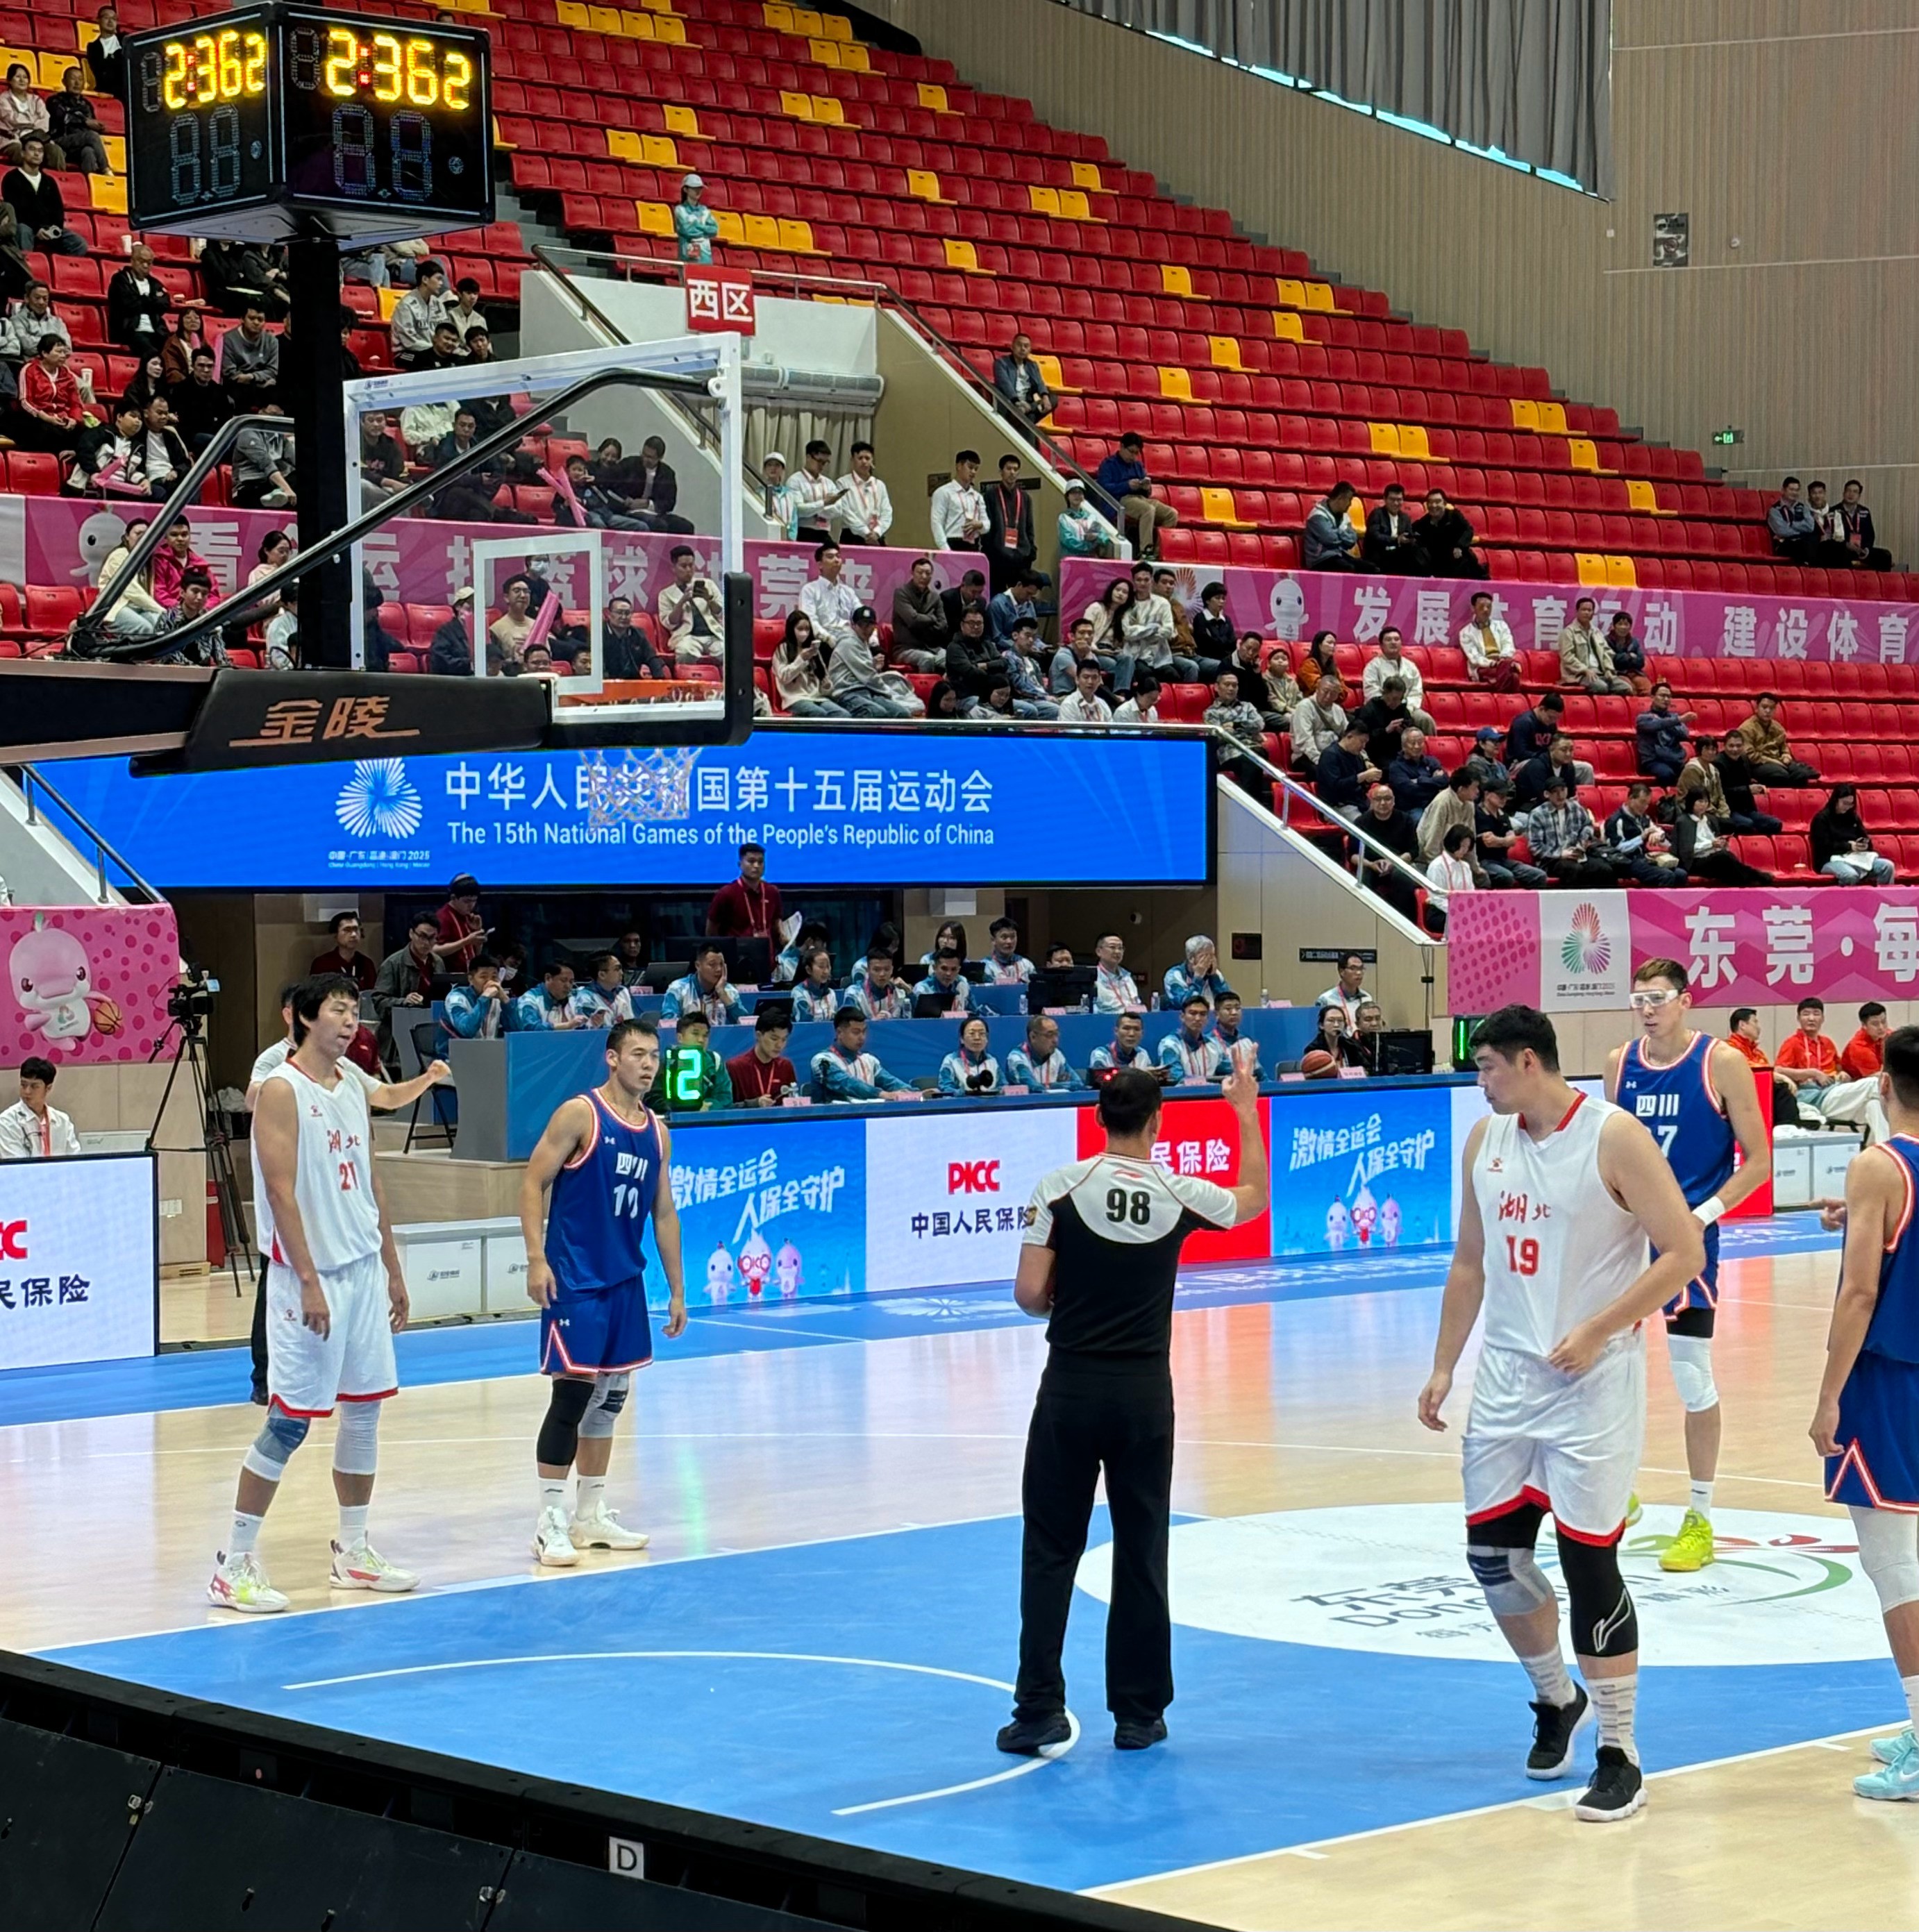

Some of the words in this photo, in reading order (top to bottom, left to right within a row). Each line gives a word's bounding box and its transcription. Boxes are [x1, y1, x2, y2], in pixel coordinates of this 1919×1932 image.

[687, 279, 753, 322] 西区
[1723, 605, 1910, 664] 建设体育
[229, 696, 420, 747] 金陵
[447, 822, 486, 844] The
[494, 822, 537, 844] 15th
[544, 822, 626, 844] National
[632, 823, 698, 844] Games
[704, 822, 723, 844] of
[728, 823, 757, 845] the
[763, 823, 838, 849] People's
[844, 823, 916, 849] Republic
[924, 823, 941, 845] of
[946, 823, 994, 845] China
[1636, 1094, 1680, 1117] 四川
[1289, 1112, 1382, 1172] 激情全运会
[339, 1161, 359, 1191] 21
[615, 1152, 648, 1182] 四川
[948, 1159, 1000, 1195] PICC
[1346, 1129, 1435, 1198] 人保全守护
[732, 1166, 845, 1245] 人保全守护
[1105, 1188, 1151, 1225] 98
[1498, 1190, 1552, 1224] 湖北
[1506, 1235, 1539, 1276] 19
[617, 1843, 637, 1872] D
